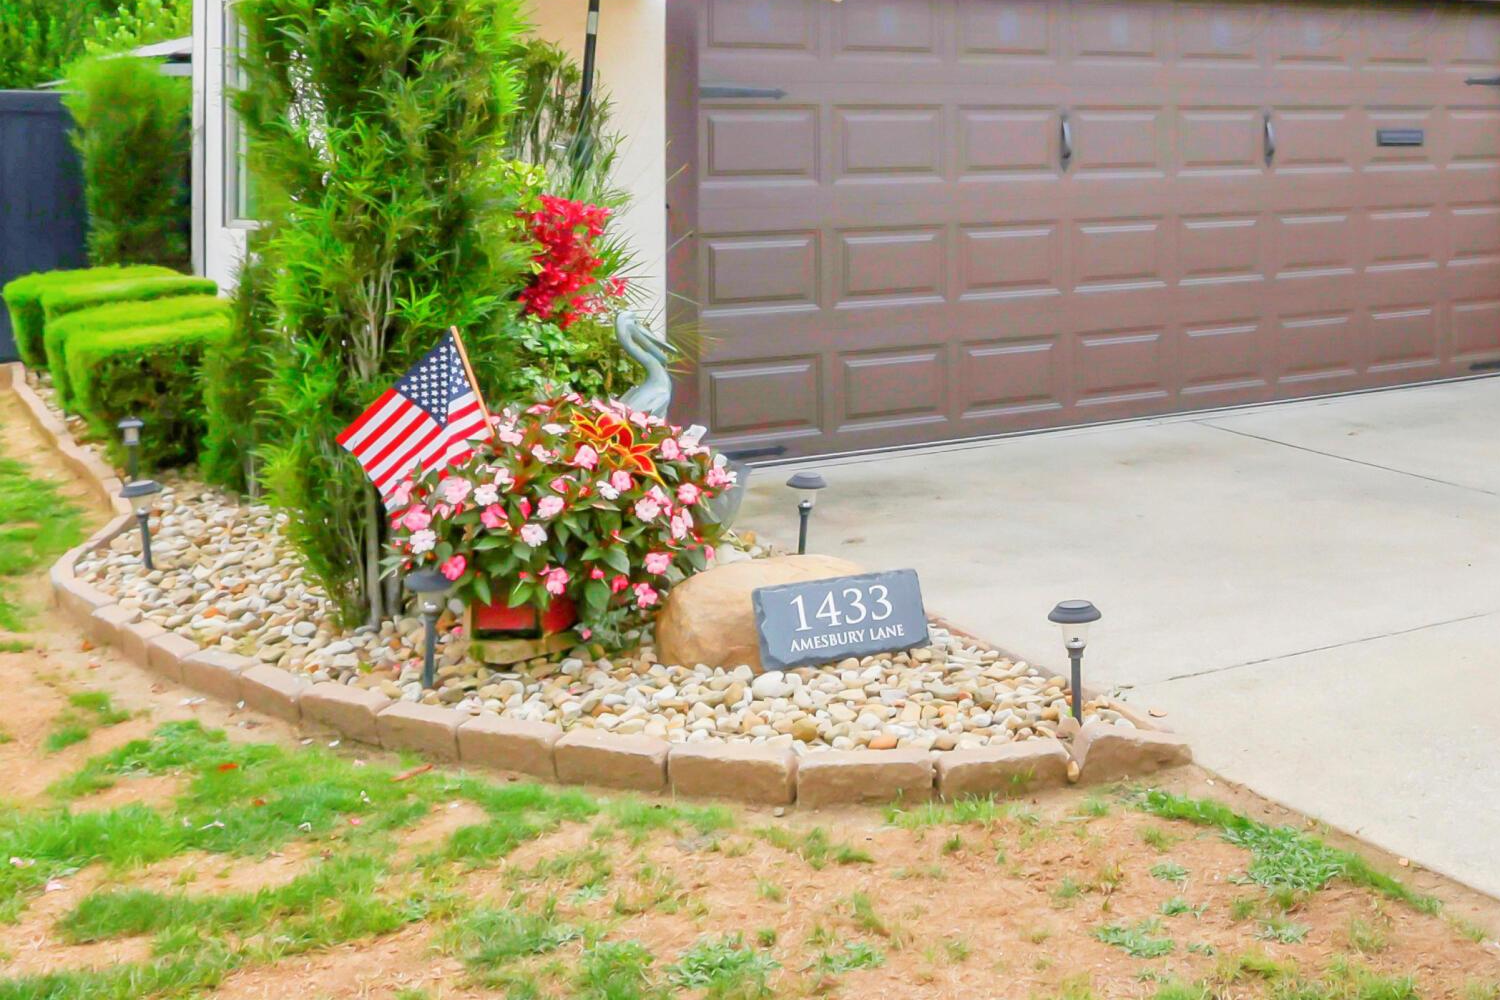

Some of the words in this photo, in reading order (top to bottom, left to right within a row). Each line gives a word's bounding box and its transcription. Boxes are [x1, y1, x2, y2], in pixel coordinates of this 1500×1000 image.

[790, 584, 893, 632] 1433
[790, 629, 865, 653] AMESBURY
[869, 624, 905, 641] LANE
